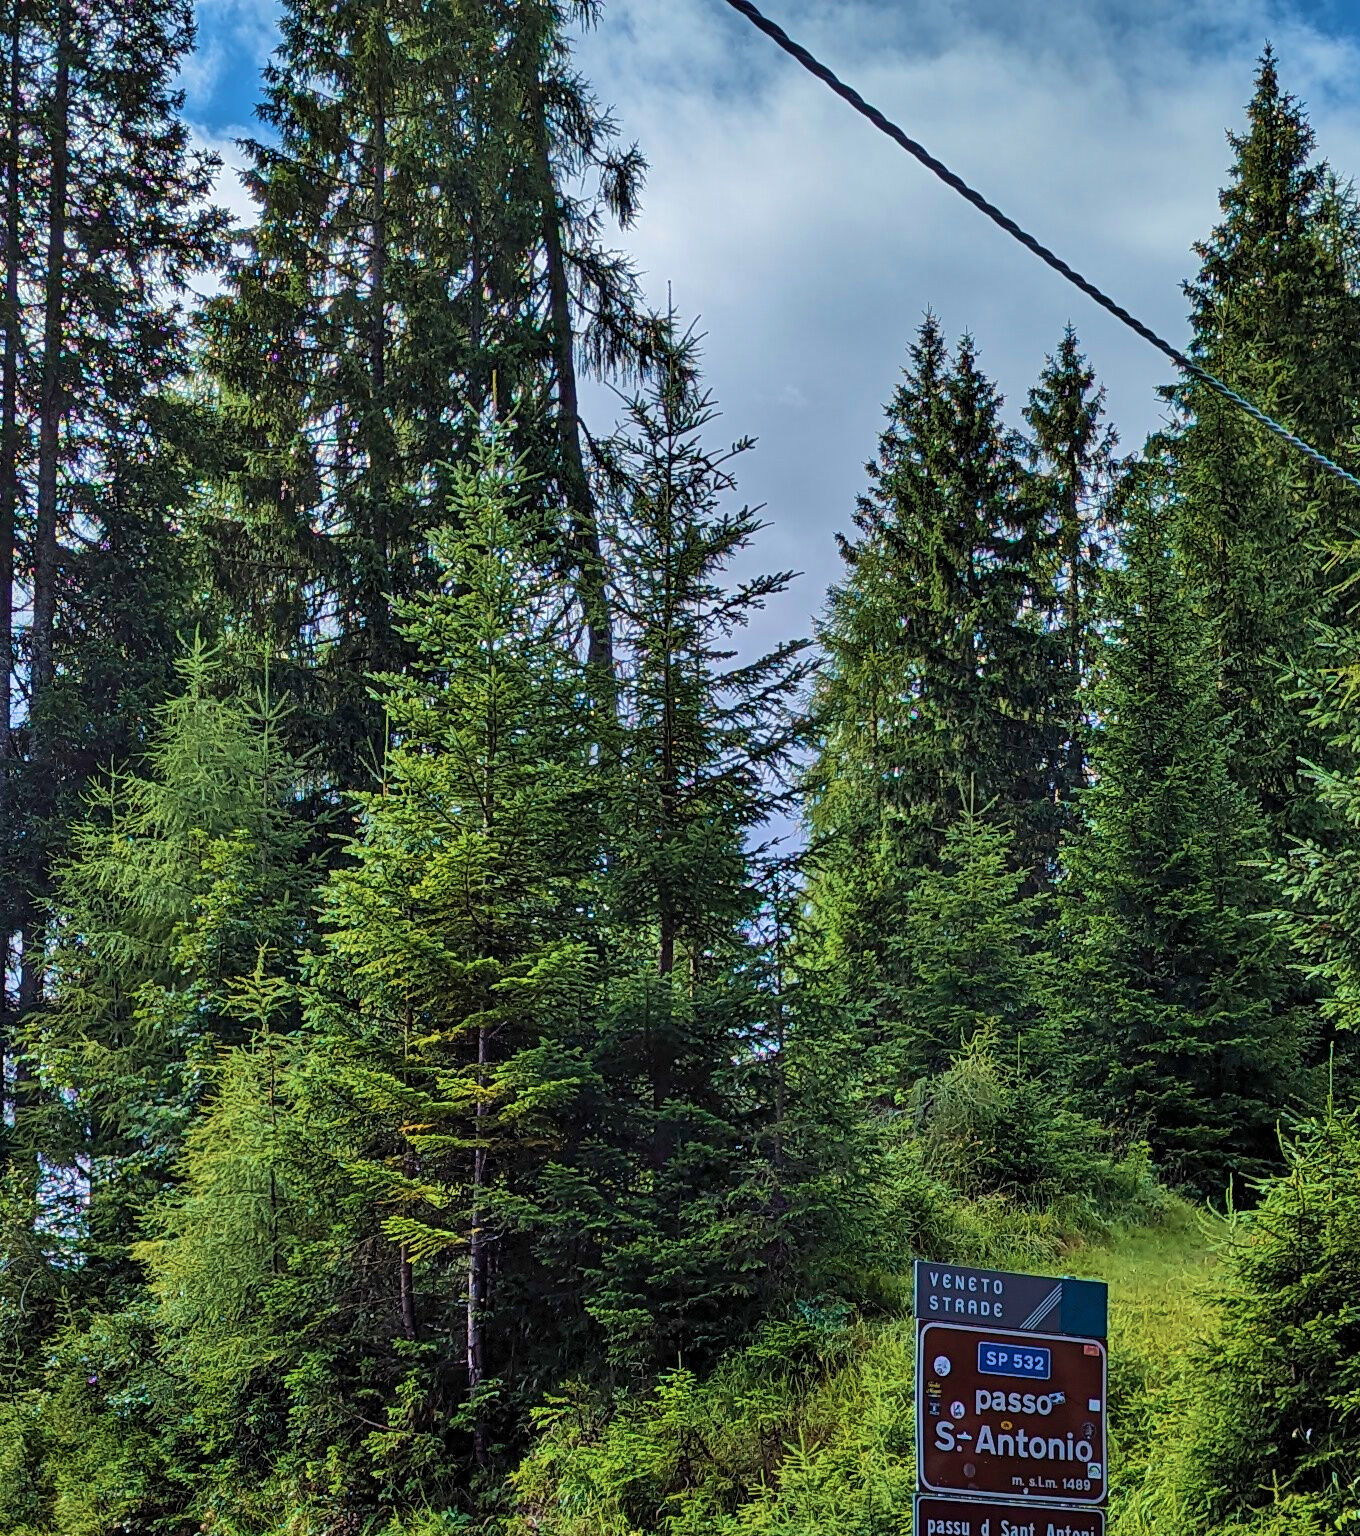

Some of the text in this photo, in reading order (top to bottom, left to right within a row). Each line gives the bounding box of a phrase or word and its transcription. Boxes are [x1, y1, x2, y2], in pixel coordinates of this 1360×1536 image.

[929, 1271, 1003, 1295] VENETO
[929, 1295, 1003, 1318] STRADE
[986, 1351, 1044, 1371] SP 532
[975, 1389, 1053, 1416] passo
[975, 1425, 1093, 1463] Antonio
[1062, 1477, 1091, 1491] 1489
